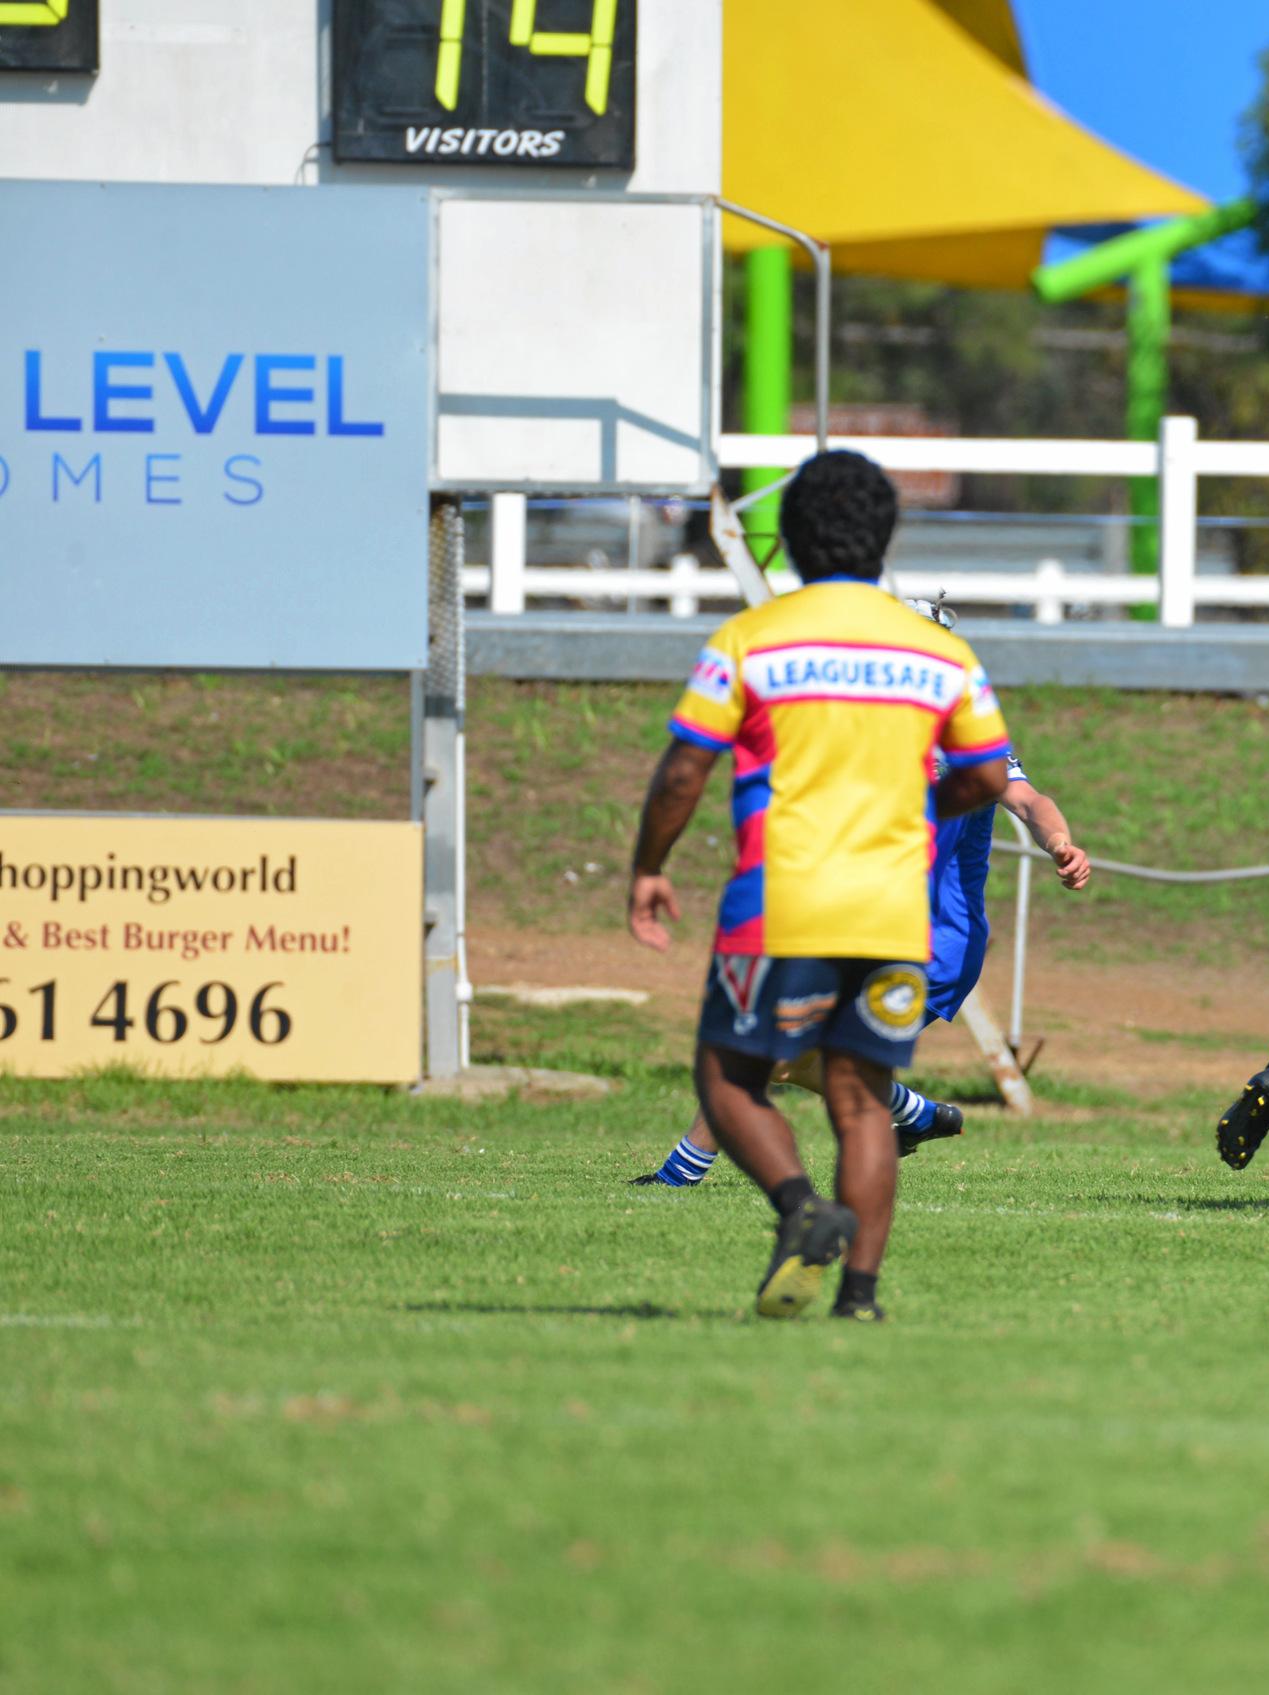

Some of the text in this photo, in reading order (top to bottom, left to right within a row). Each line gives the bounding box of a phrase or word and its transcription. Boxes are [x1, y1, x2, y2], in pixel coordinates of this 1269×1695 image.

[405, 126, 566, 157] VISITORS
[25, 350, 385, 436] LEVEL
[0, 452, 264, 506] MES
[767, 659, 944, 698] LEAGUESAFE
[3, 920, 351, 959] & Best Burger Menu!
[90, 979, 292, 1045] 4696
